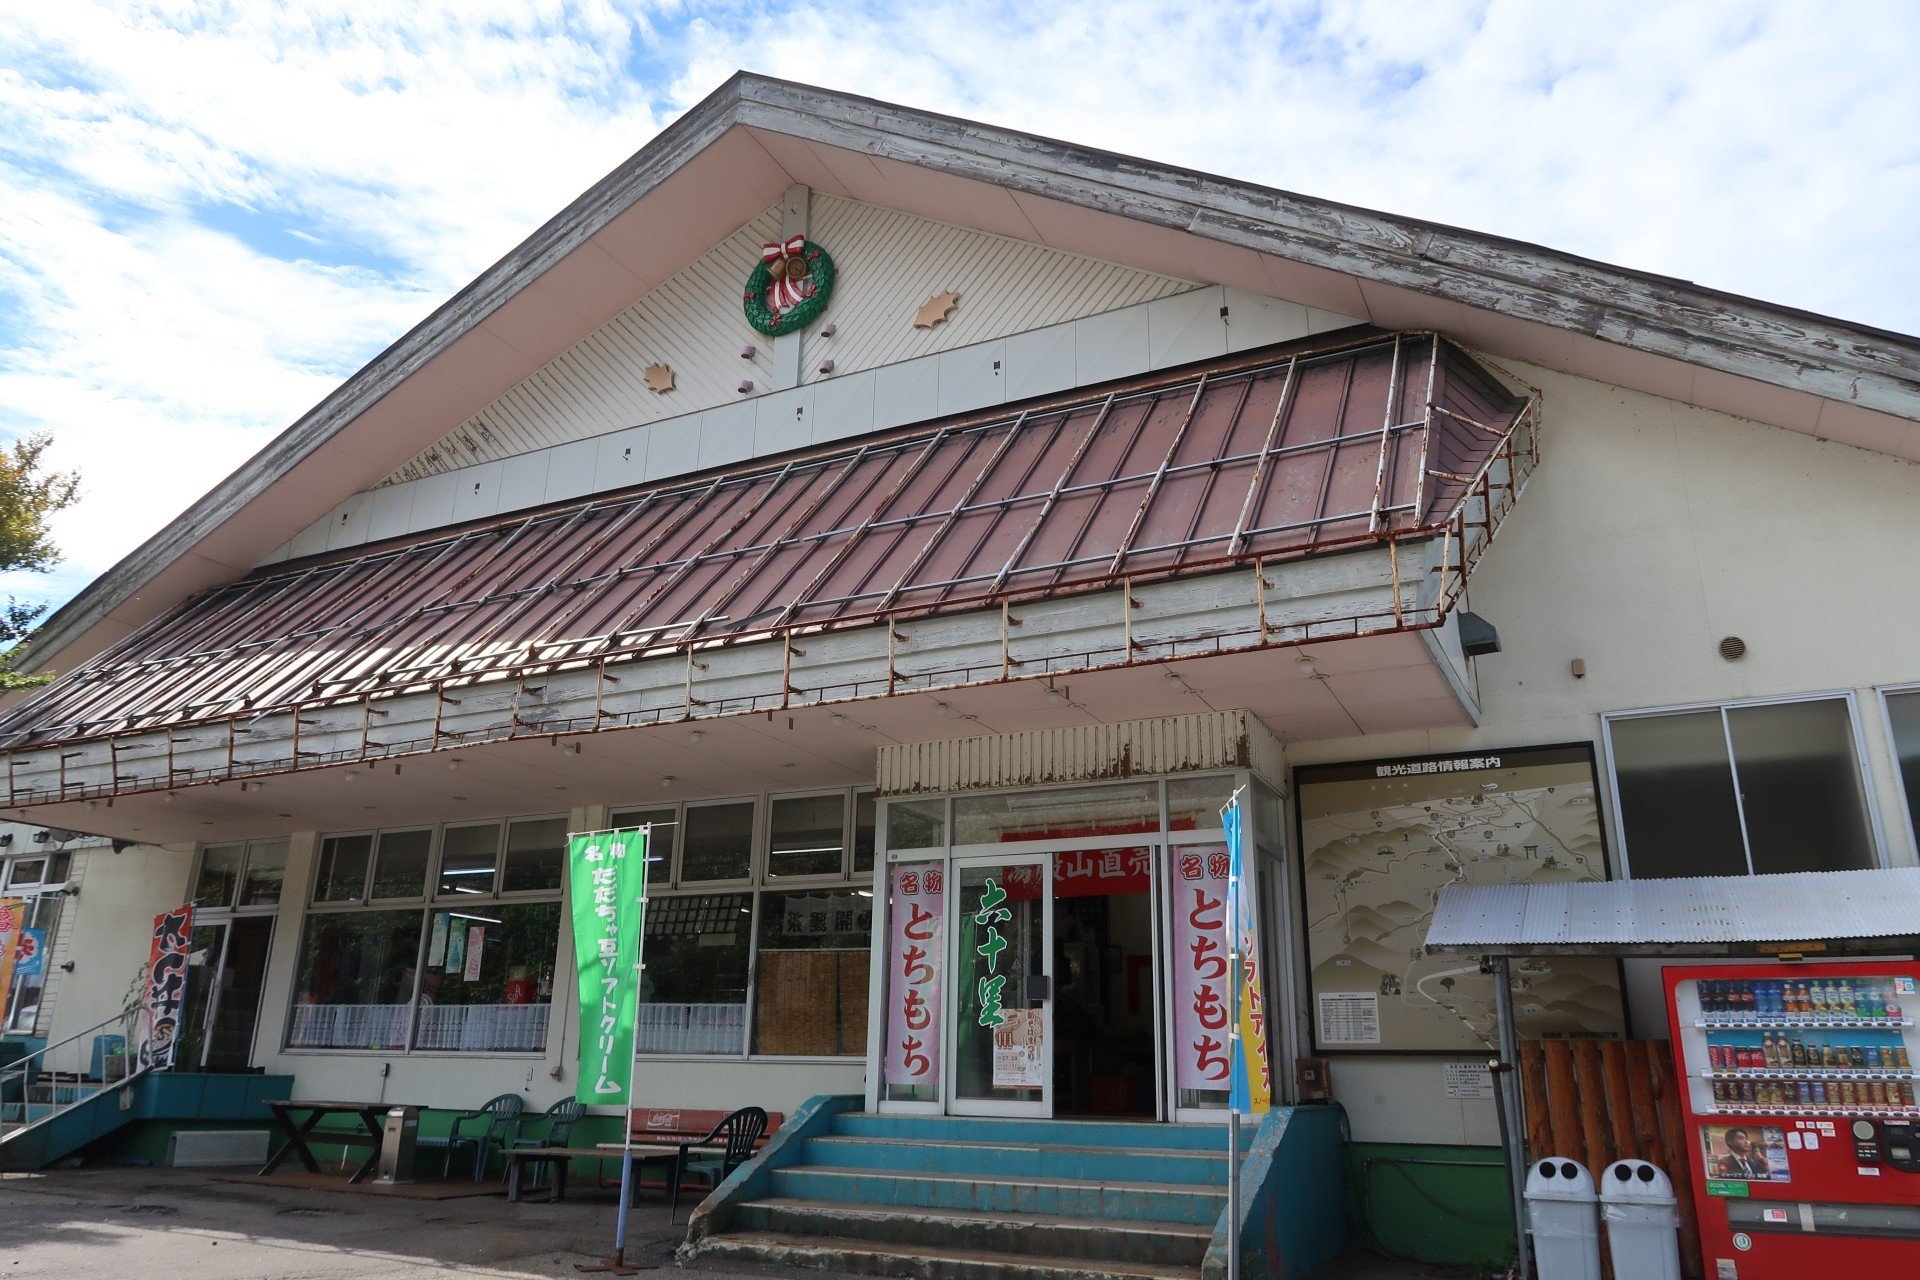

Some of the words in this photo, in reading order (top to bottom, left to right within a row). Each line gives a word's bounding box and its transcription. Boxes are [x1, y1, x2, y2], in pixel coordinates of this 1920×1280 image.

[1376, 756, 1501, 777] 観光道路情報案内
[584, 843, 626, 862] 名物
[1180, 853, 1230, 880] 名物
[900, 871, 943, 895] 名物
[592, 865, 622, 1095] だだちゃ豆ソフトクリーム
[902, 902, 934, 1076] とちもち
[1189, 888, 1230, 1081] とちもち
